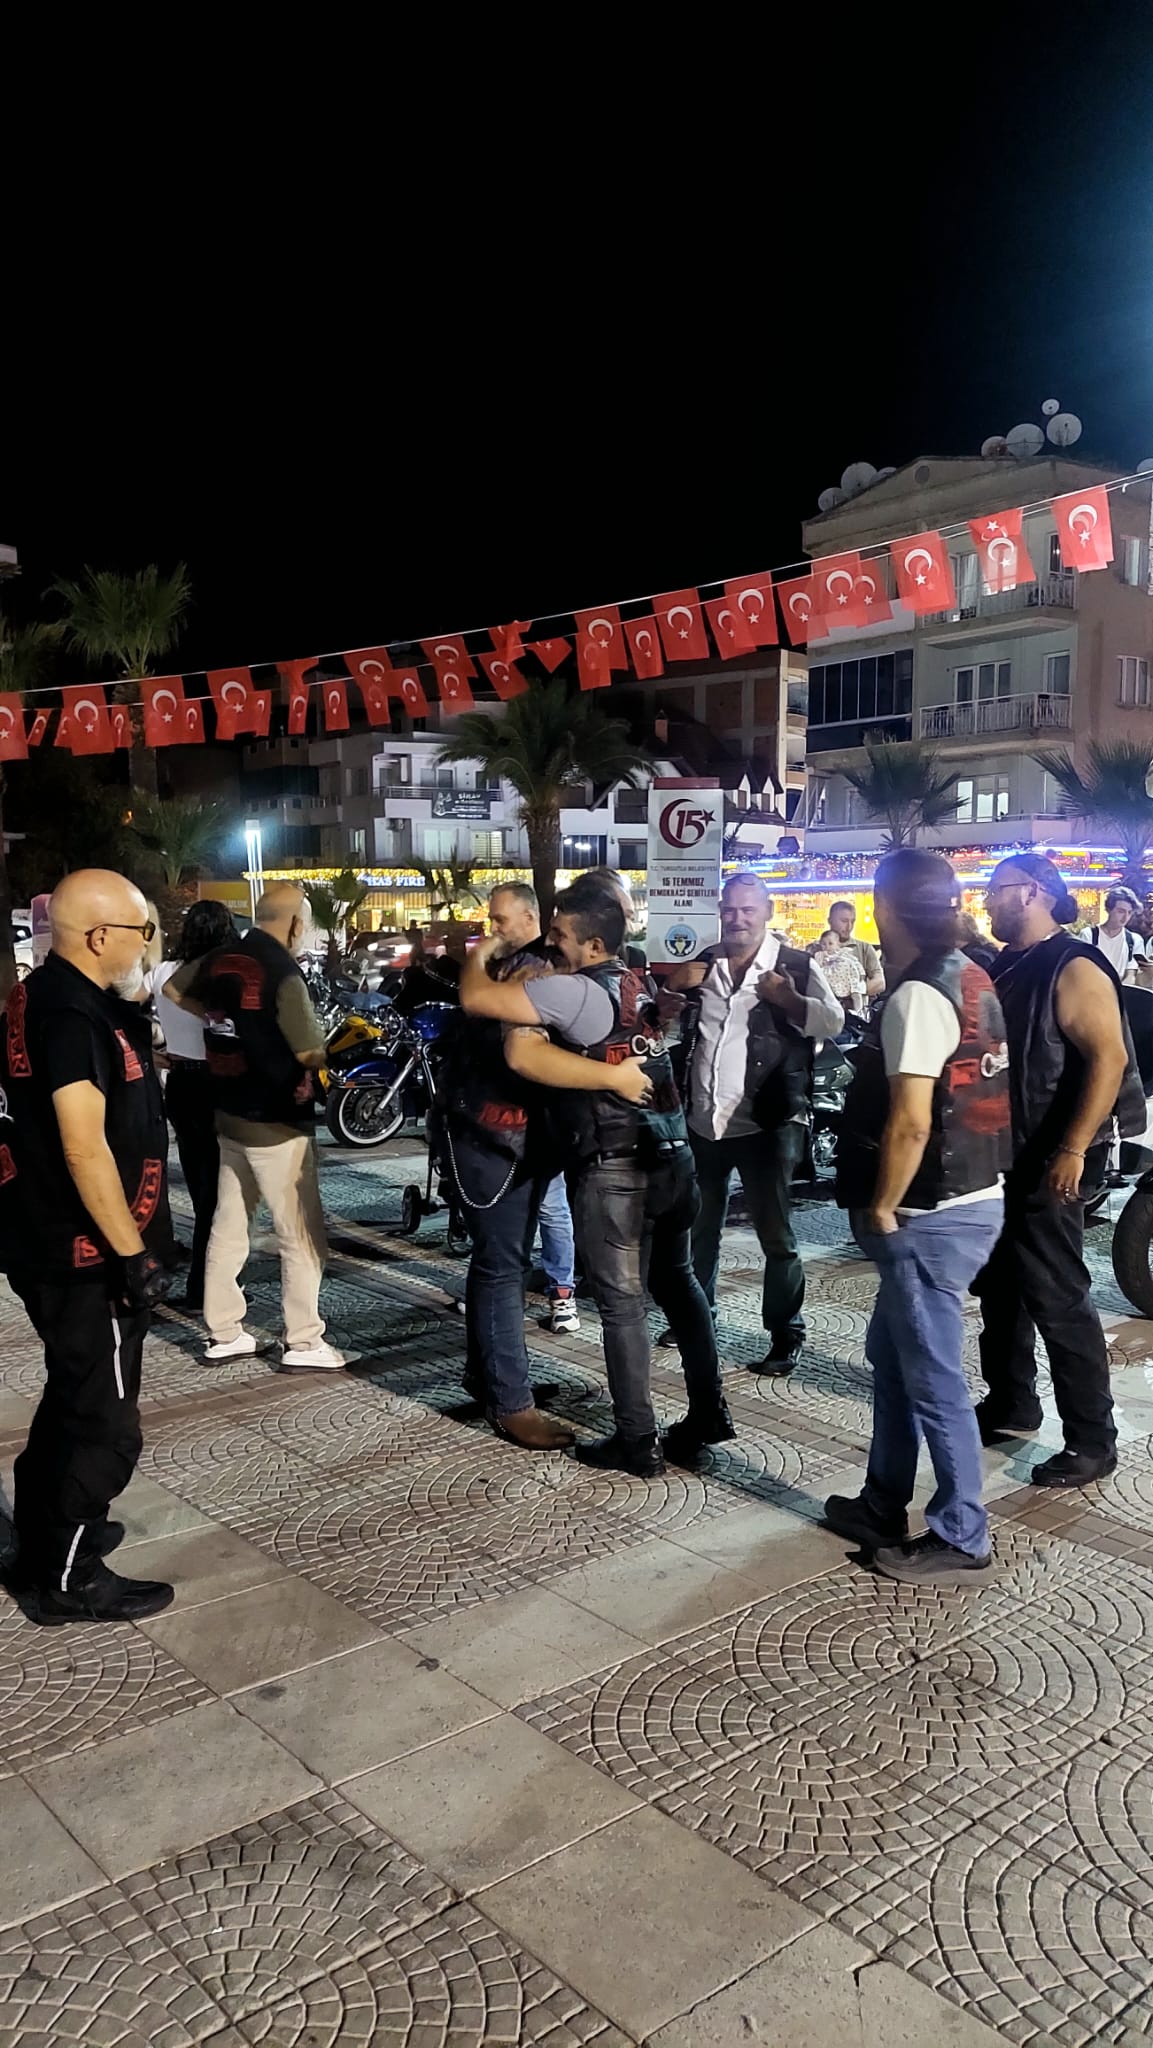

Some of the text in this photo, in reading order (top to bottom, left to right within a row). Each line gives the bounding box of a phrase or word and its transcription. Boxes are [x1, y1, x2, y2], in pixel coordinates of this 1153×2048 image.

[676, 810, 706, 841] 15
[662, 877, 705, 887] 15 TEMMUZ
[673, 899, 693, 907] ALANI
